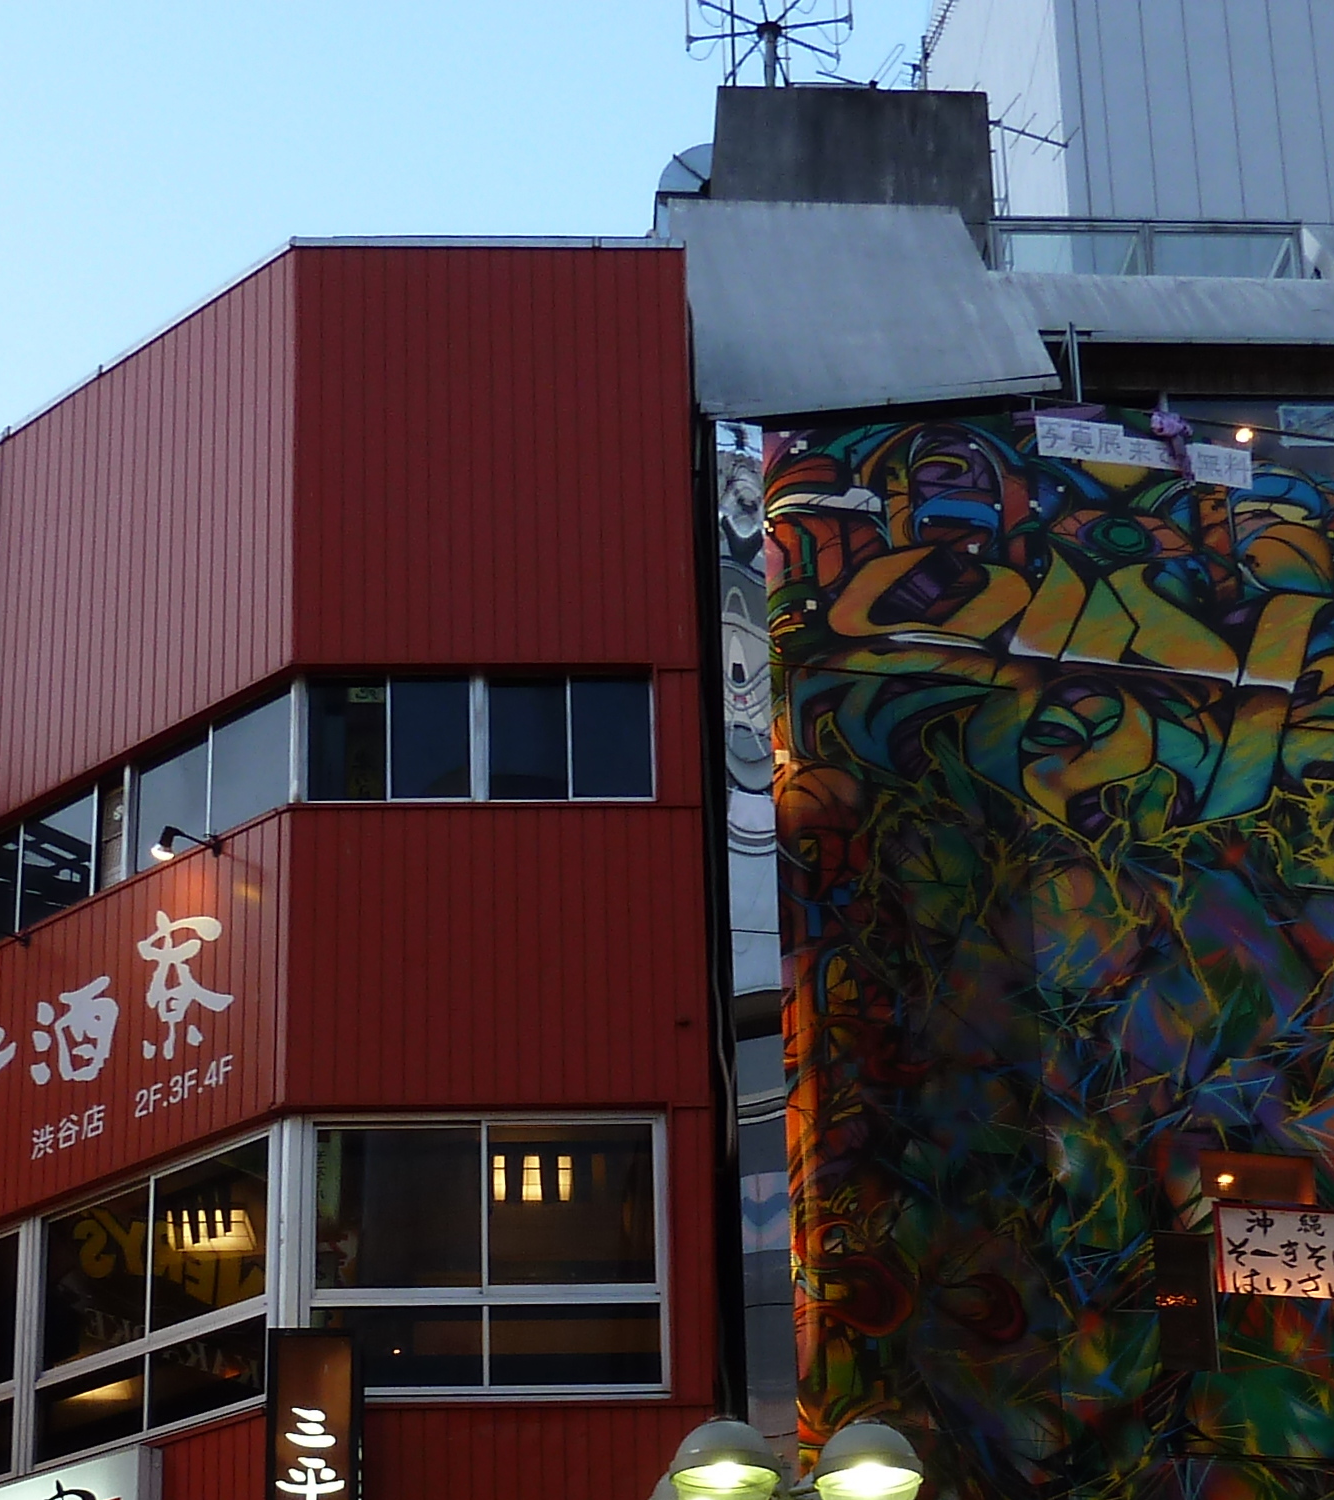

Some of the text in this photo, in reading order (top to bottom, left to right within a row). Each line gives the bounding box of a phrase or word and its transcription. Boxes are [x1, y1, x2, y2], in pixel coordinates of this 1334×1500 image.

[31, 1054, 233, 1160] 渋谷店 2F.3F.4F
[1245, 1209, 1326, 1237] 沖縄
